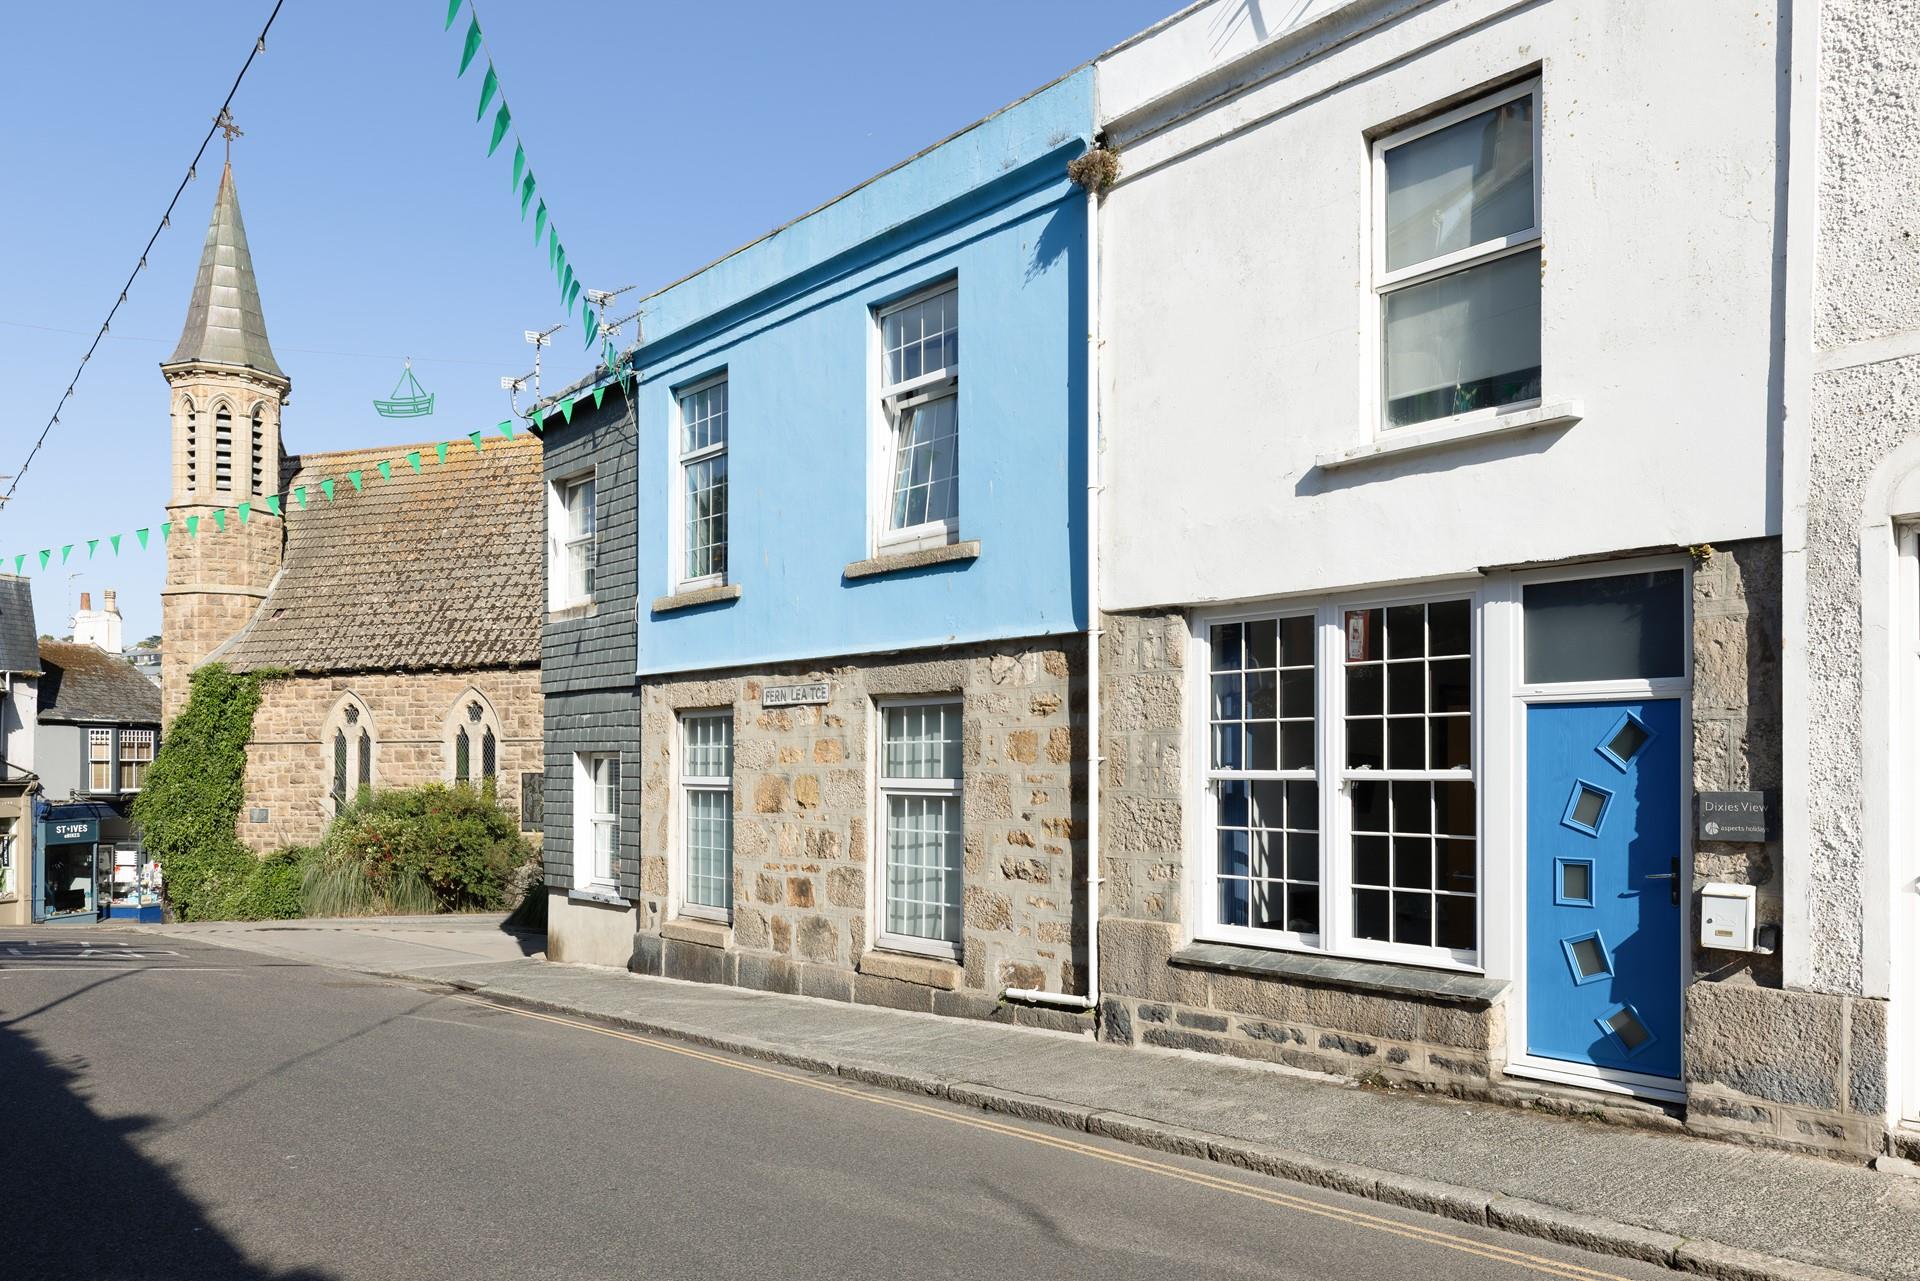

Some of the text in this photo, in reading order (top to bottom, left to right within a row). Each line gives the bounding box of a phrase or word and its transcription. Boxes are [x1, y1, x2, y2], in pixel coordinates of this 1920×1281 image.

[765, 686, 827, 703] FERN LEA TCE
[1705, 801, 1769, 813] Dixies View
